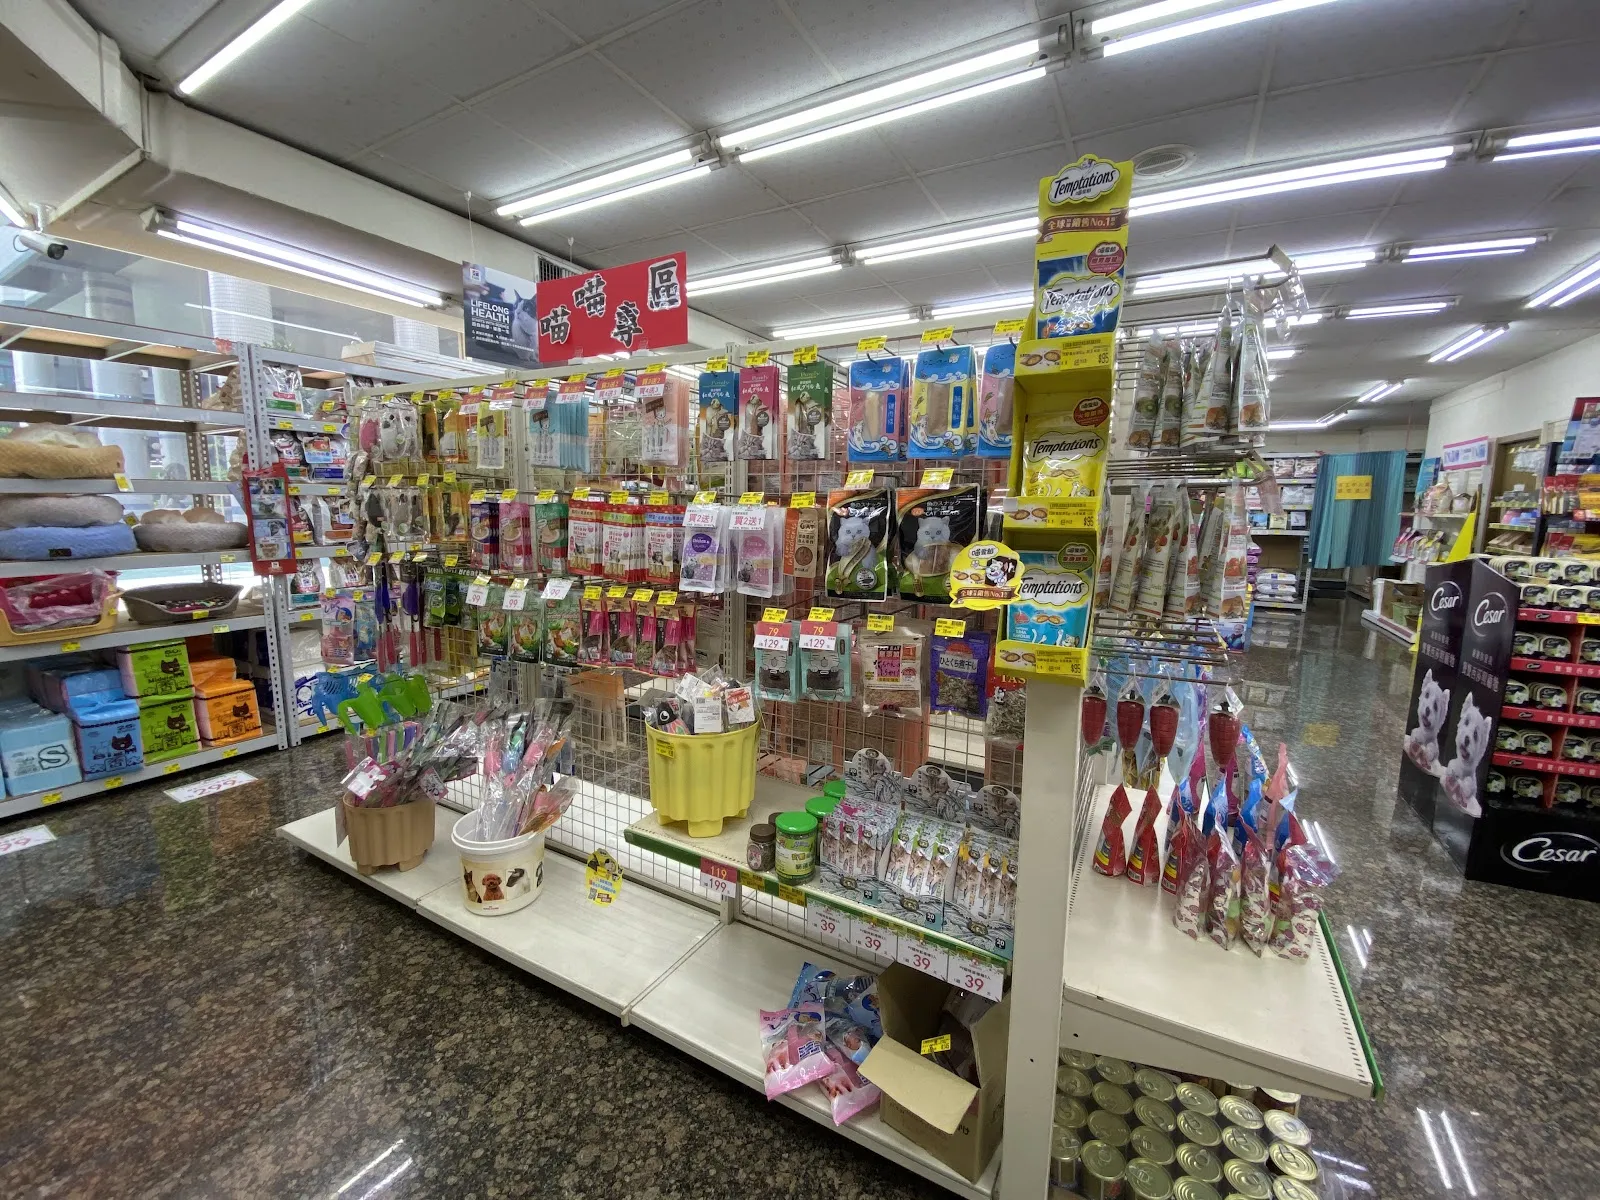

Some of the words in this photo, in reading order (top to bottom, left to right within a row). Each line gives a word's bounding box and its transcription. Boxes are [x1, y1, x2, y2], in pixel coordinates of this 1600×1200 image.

[1054, 170, 1116, 198] Temptations
[471, 299, 510, 315] LIFELONG
[471, 307, 510, 324] HEALTH
[1032, 438, 1101, 458] Temptations
[688, 514, 714, 523] 買2送1
[734, 516, 762, 526] 買2送1
[472, 595, 481, 603] 99
[549, 589, 561, 597] 99
[1431, 582, 1460, 612] Cesar
[508, 599, 518, 607] 99
[1474, 598, 1506, 627] Cesar
[768, 627, 779, 636] 79
[813, 626, 824, 636] 79
[764, 639, 779, 648] 129
[809, 639, 825, 648] 129
[939, 656, 977, 671] ひとくち煮干し
[38, 744, 70, 770] S
[194, 780, 236, 795] 299
[1511, 837, 1598, 864] Cesar
[710, 866, 727, 879] 119
[710, 879, 727, 892] 199
[820, 920, 836, 934] 39
[864, 937, 882, 951] 39
[913, 954, 931, 970] 39
[964, 975, 984, 991] 39
